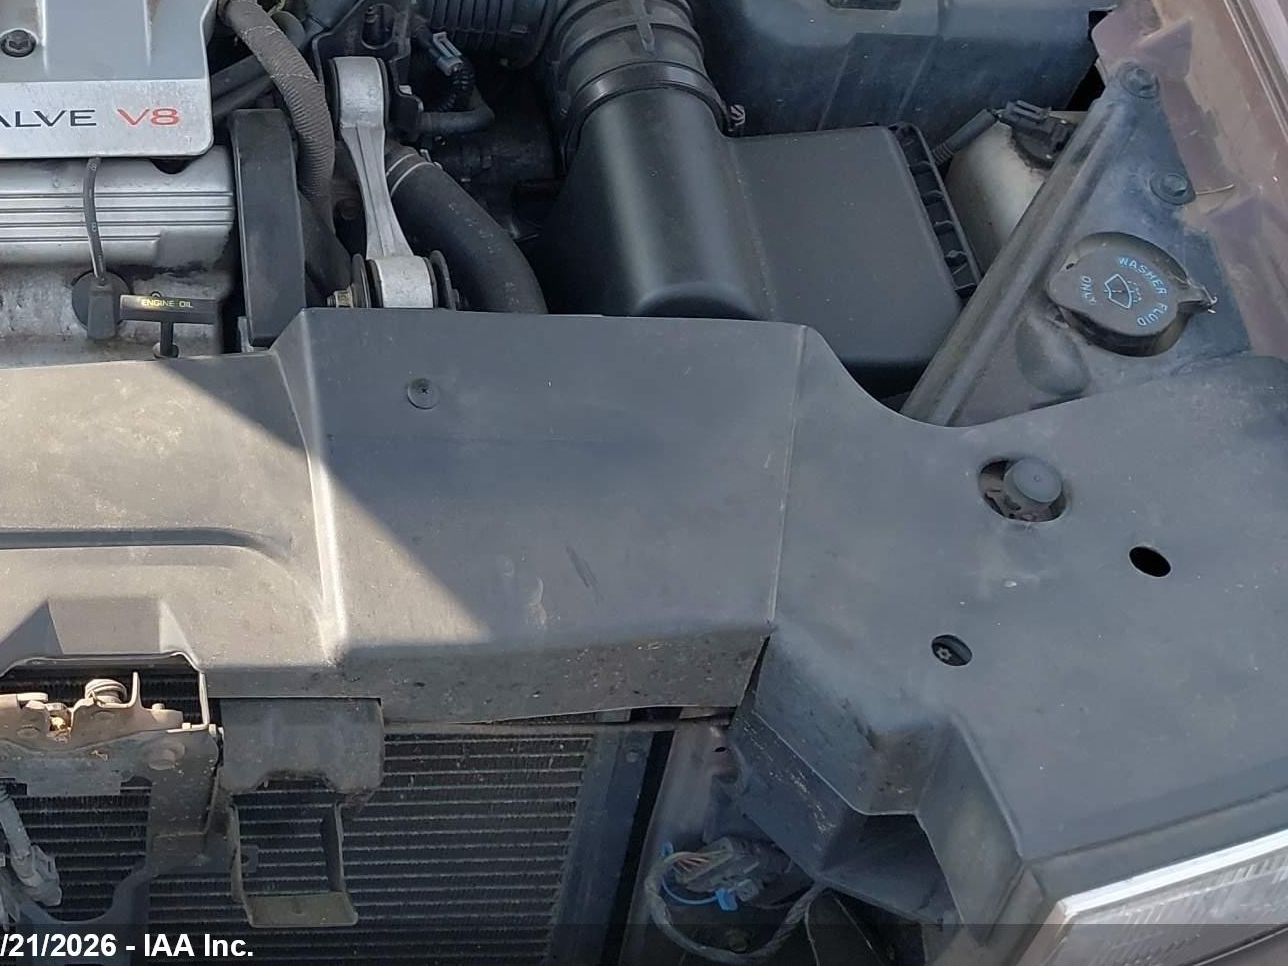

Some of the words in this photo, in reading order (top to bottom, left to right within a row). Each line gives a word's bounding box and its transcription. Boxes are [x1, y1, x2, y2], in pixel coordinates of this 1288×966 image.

[116, 107, 181, 126] V8
[1118, 256, 1168, 295] WASHER
[140, 298, 176, 307] ENGINE
[178, 300, 194, 308] OIL
[1079, 275, 1097, 306] ONLY
[1137, 302, 1169, 327] FLUID
